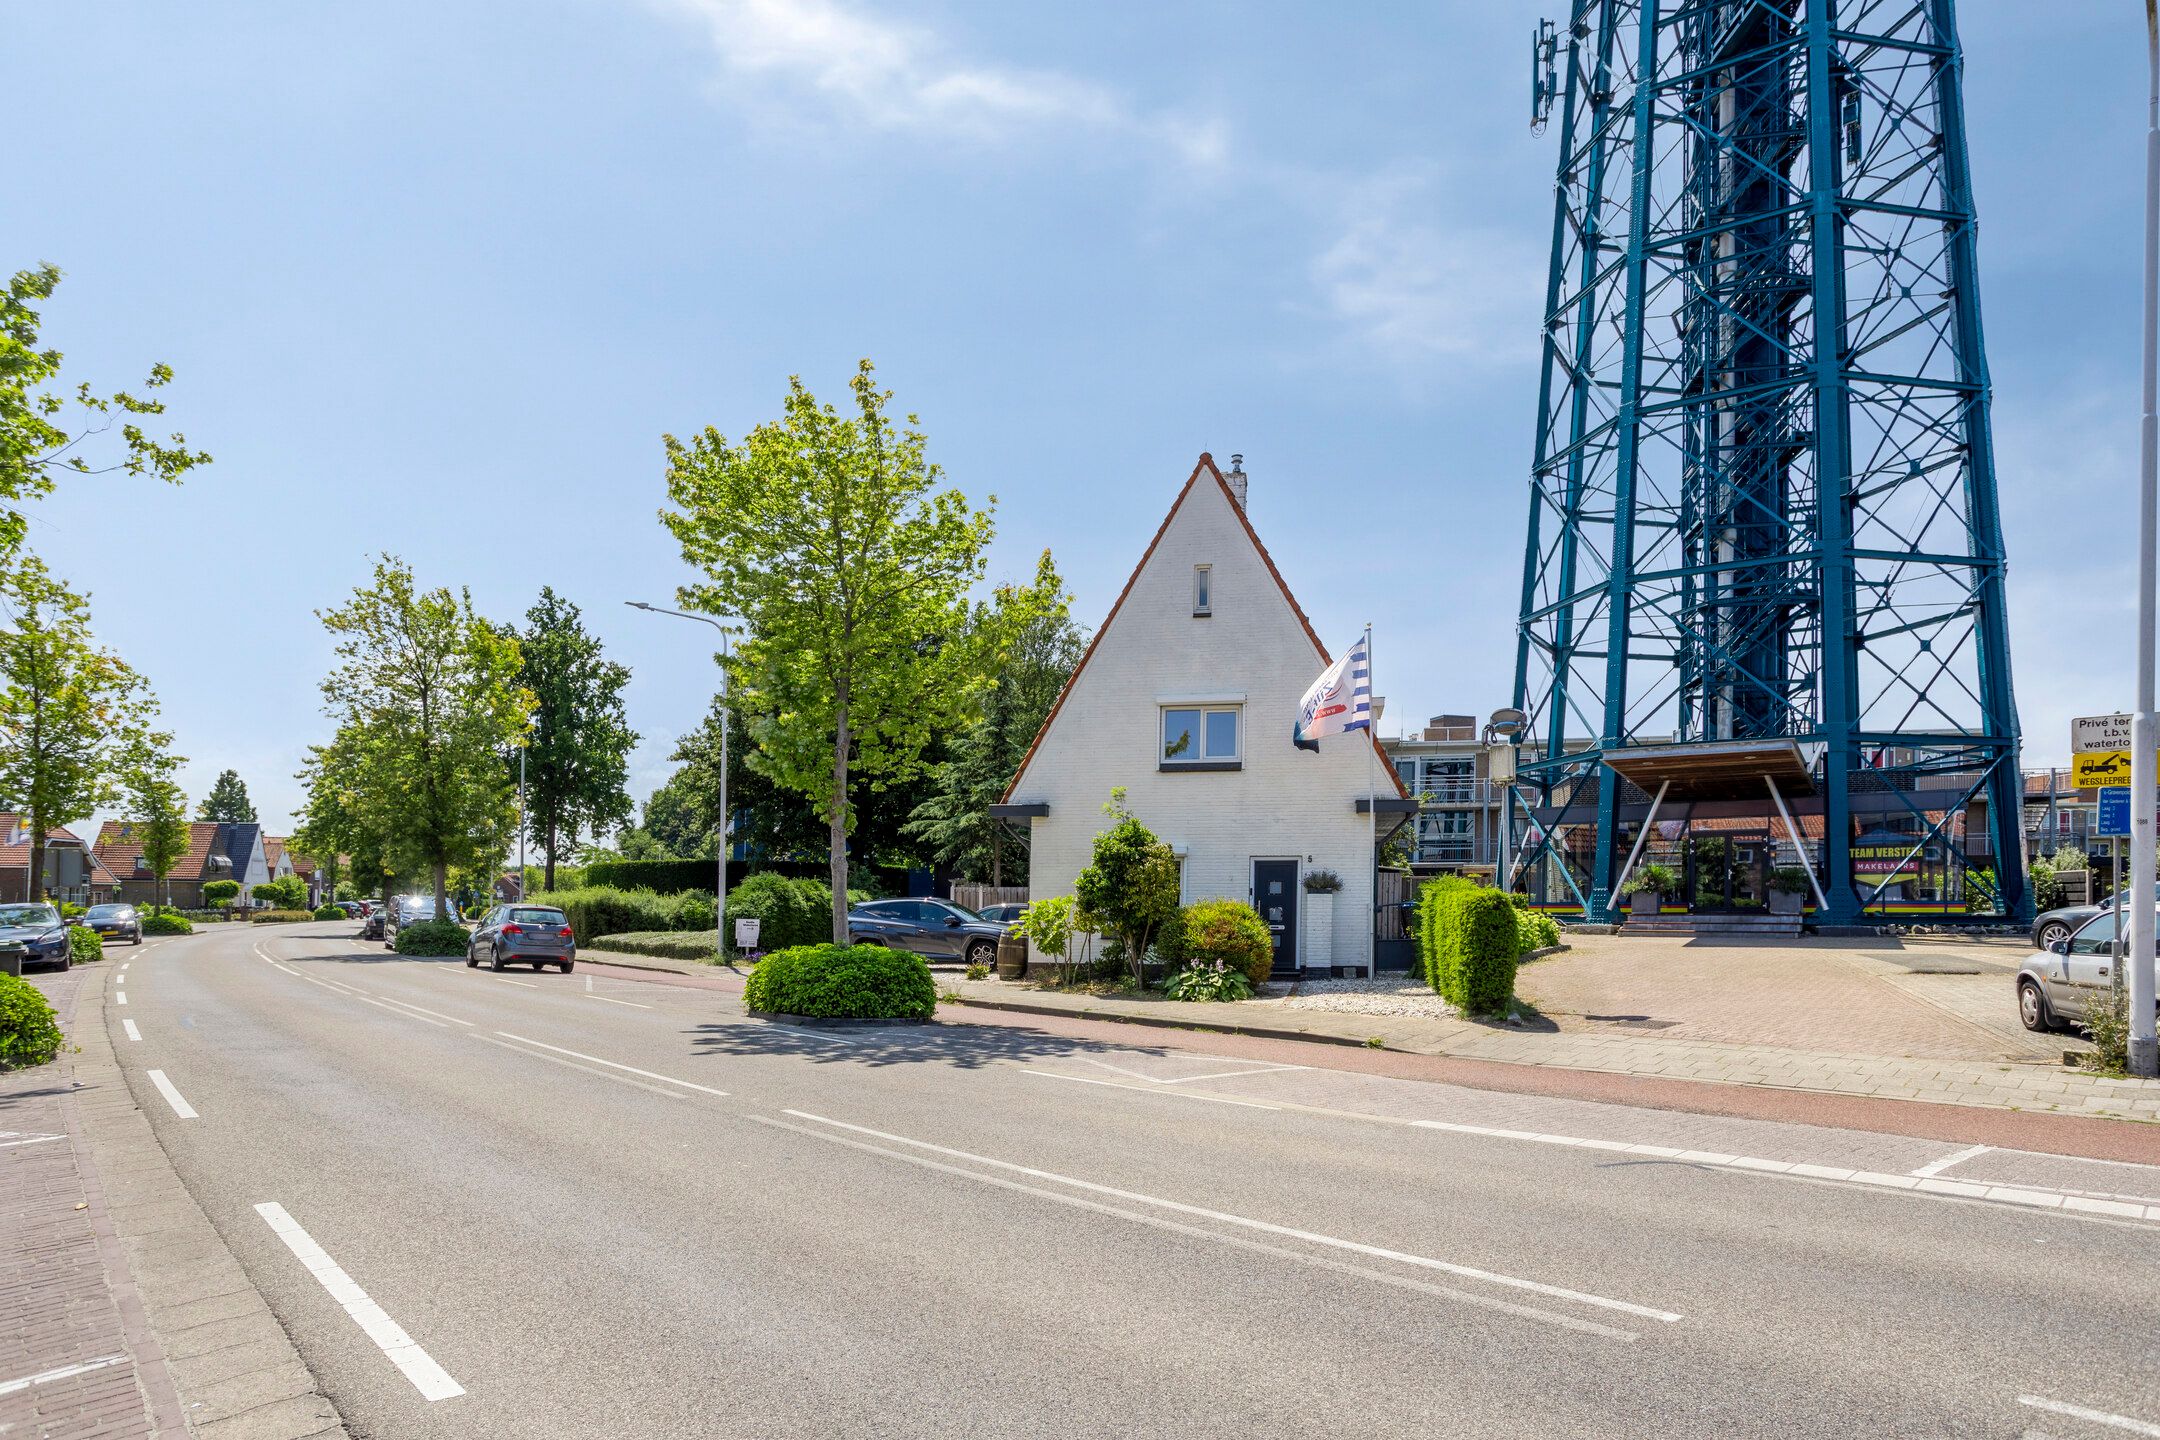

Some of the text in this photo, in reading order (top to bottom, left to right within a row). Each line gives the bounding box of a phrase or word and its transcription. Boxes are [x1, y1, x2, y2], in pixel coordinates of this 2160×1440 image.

[2079, 717, 2108, 729] Privé
[1849, 846, 1923, 858] TEAM VERSTEG
[1308, 855, 1313, 863] 5
[1857, 862, 1915, 870] MAKELARS
